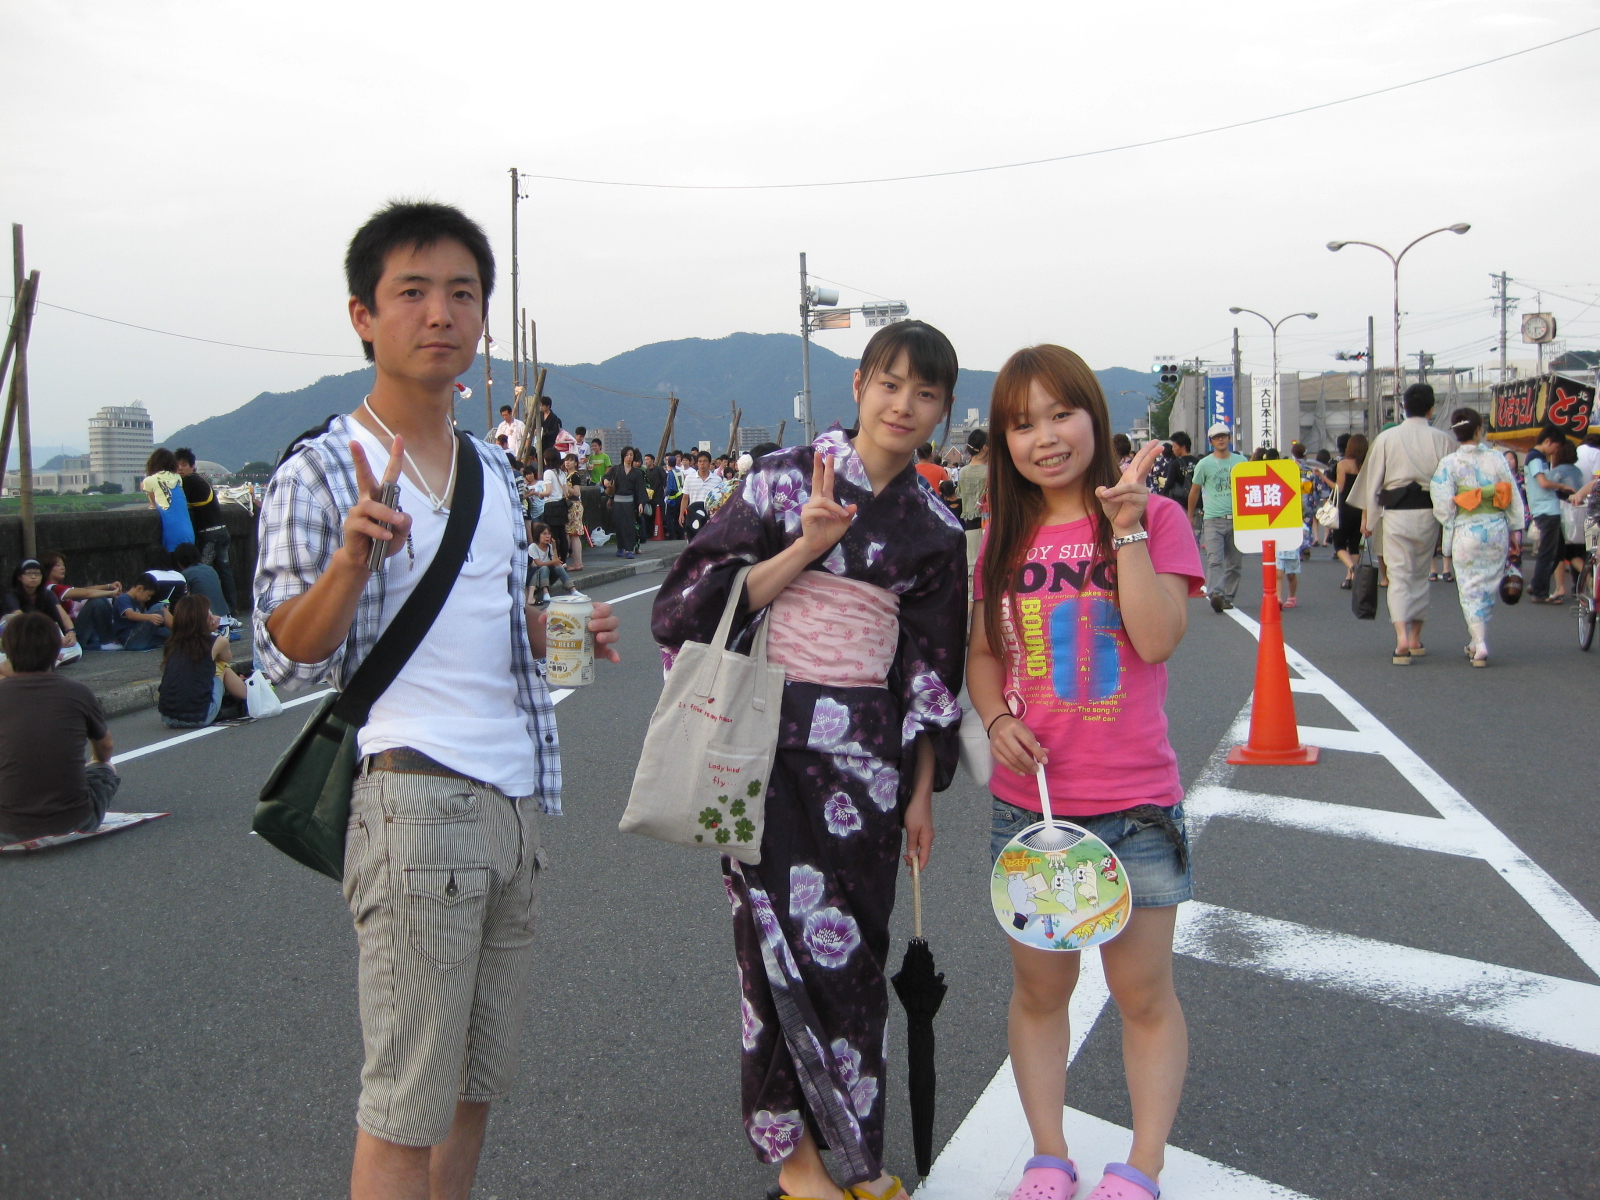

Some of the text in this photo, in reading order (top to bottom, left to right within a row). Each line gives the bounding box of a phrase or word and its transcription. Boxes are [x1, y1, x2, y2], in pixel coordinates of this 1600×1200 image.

[1244, 484, 1282, 508] 通路
[1001, 596, 1021, 689] TOGETHER
[1021, 600, 1048, 676] BOUND
[708, 762, 724, 773] Lady
